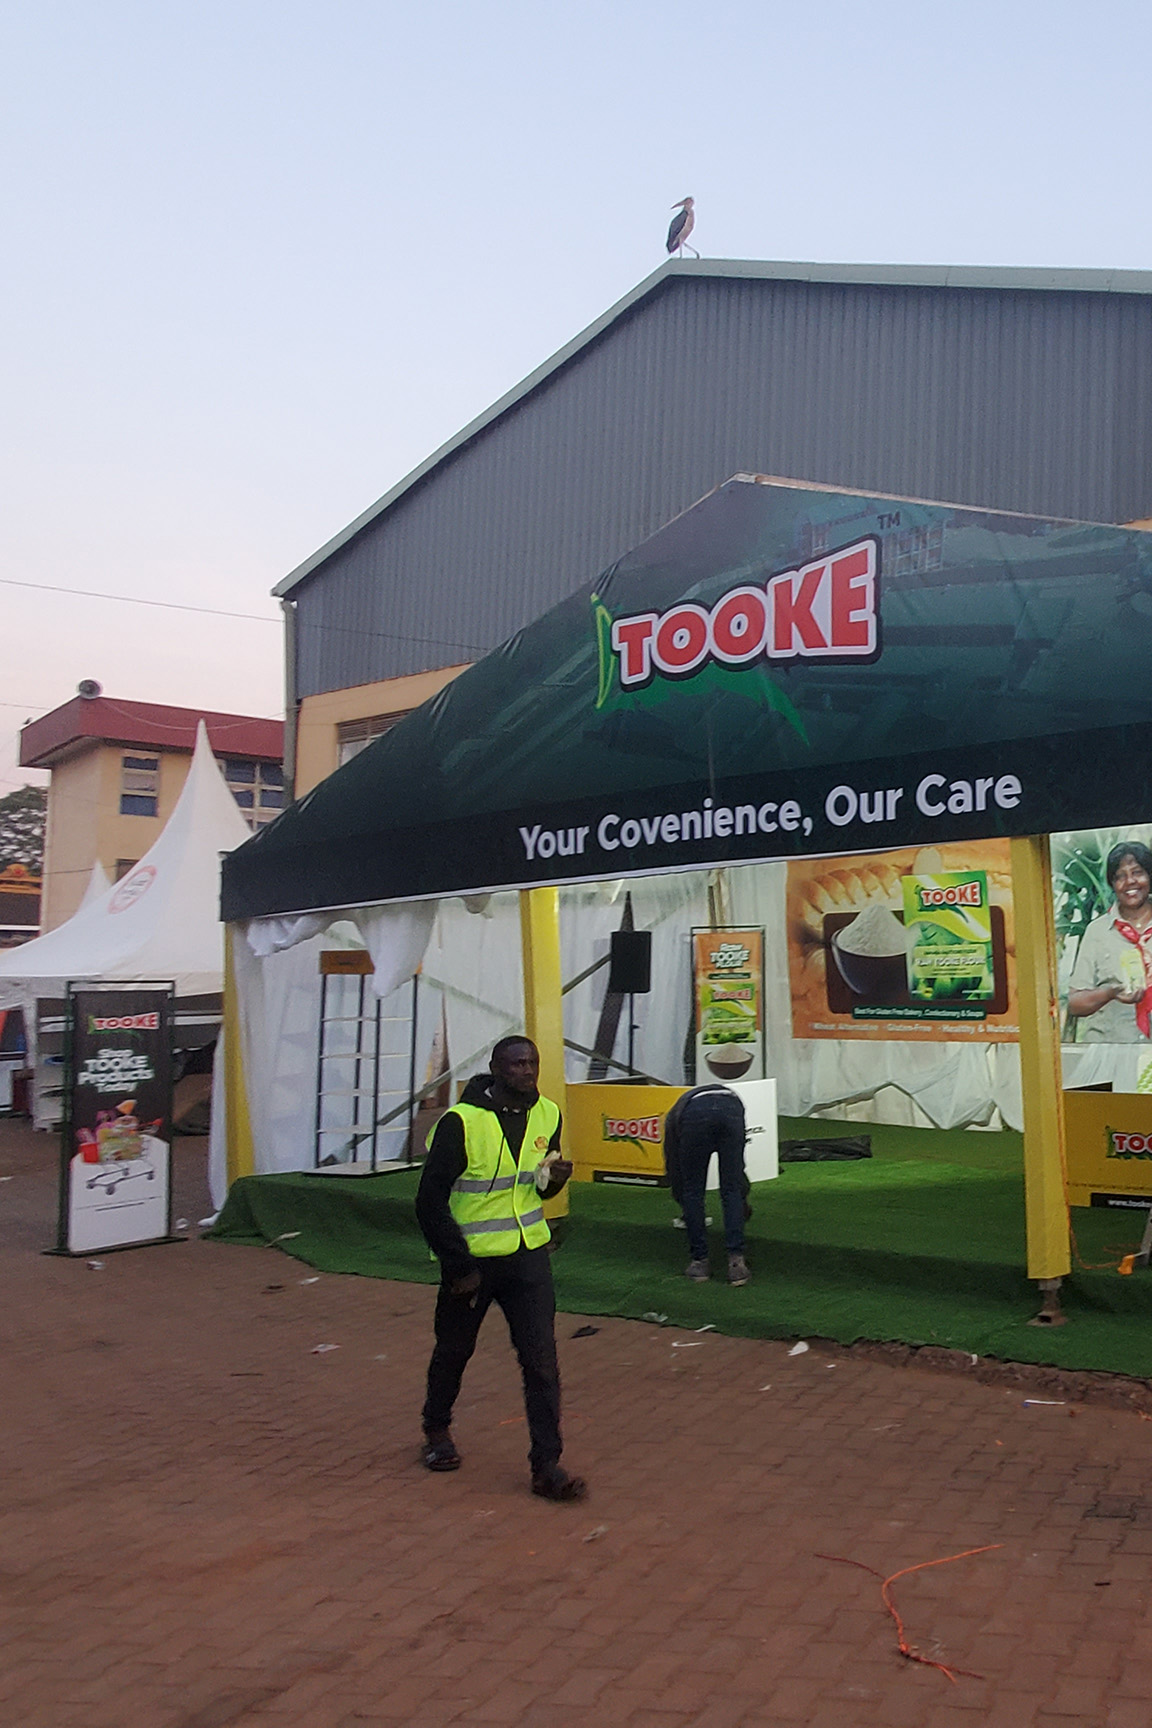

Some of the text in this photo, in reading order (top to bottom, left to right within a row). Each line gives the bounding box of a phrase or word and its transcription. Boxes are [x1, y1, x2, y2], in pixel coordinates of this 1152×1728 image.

[876, 511, 901, 530] TM
[611, 538, 880, 688] TOOKE
[518, 773, 1023, 860] Your Covenience, Our Care
[920, 881, 982, 906] TOOKE
[710, 950, 751, 963] TOOKE
[713, 988, 752, 1000] TOOKE
[93, 1011, 160, 1031] TOOKE
[83, 1055, 149, 1072] TOOKE
[77, 1069, 155, 1085] Products
[606, 1115, 662, 1143] TOOKE
